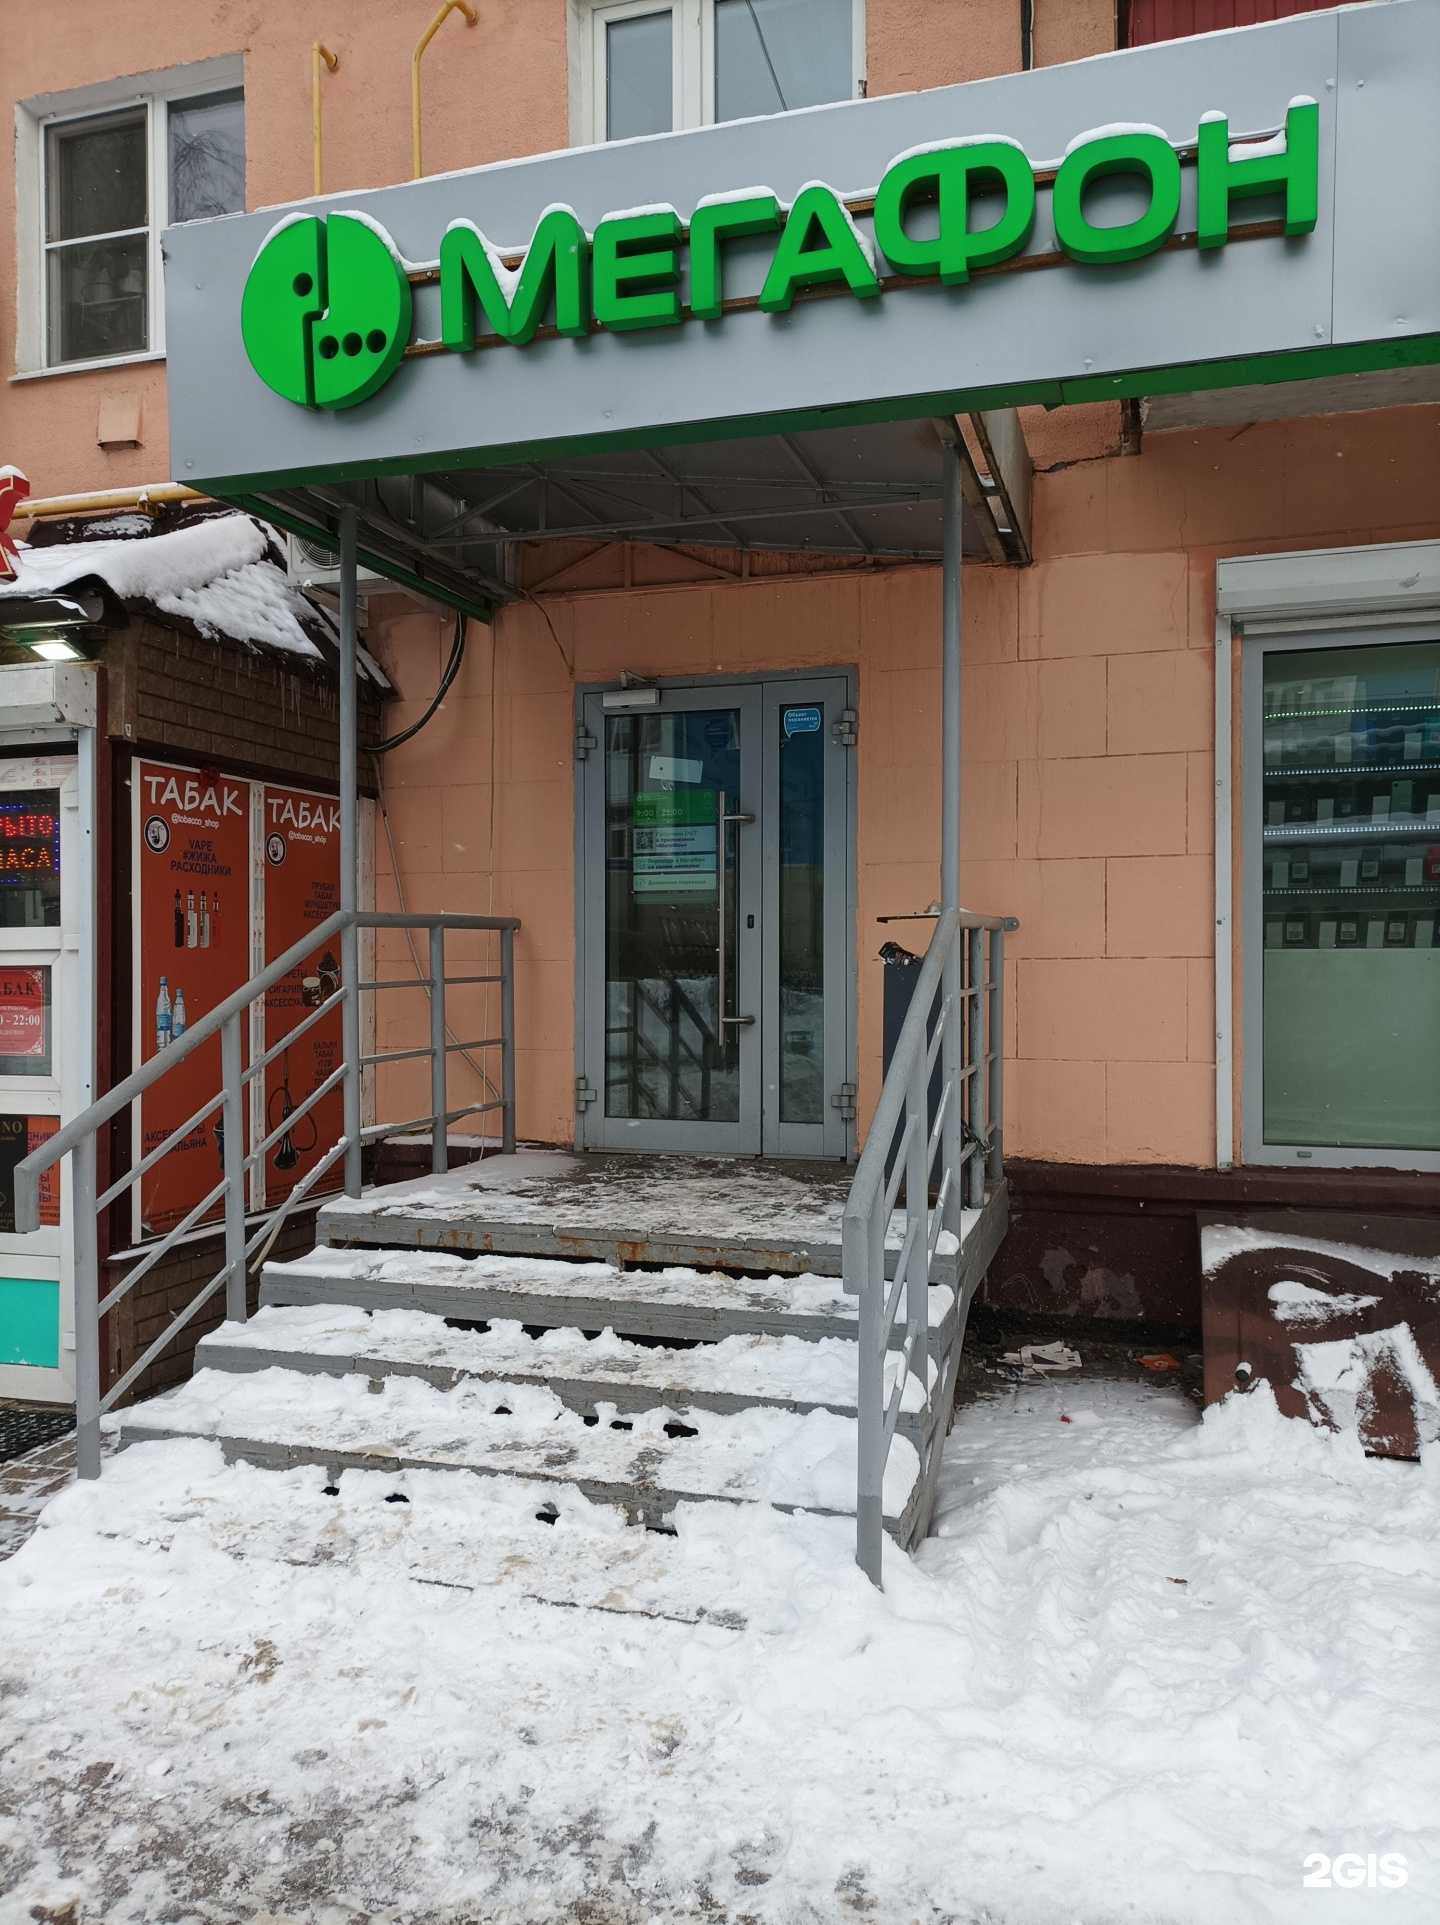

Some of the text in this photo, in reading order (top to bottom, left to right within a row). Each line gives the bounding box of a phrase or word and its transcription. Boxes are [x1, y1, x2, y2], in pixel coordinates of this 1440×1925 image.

[439, 101, 1320, 351] МЕГАФОН
[144, 775, 243, 816] ТАБАК
[171, 813, 219, 830] @tobacco_shop
[267, 798, 341, 832] ТАБАК
[189, 839, 213, 852] VAPE
[170, 860, 231, 877] РАСХОДНИКИ
[0, 982, 34, 996] БАК
[13, 1014, 40, 1026] 22:00
[0, 1120, 23, 1134] NO
